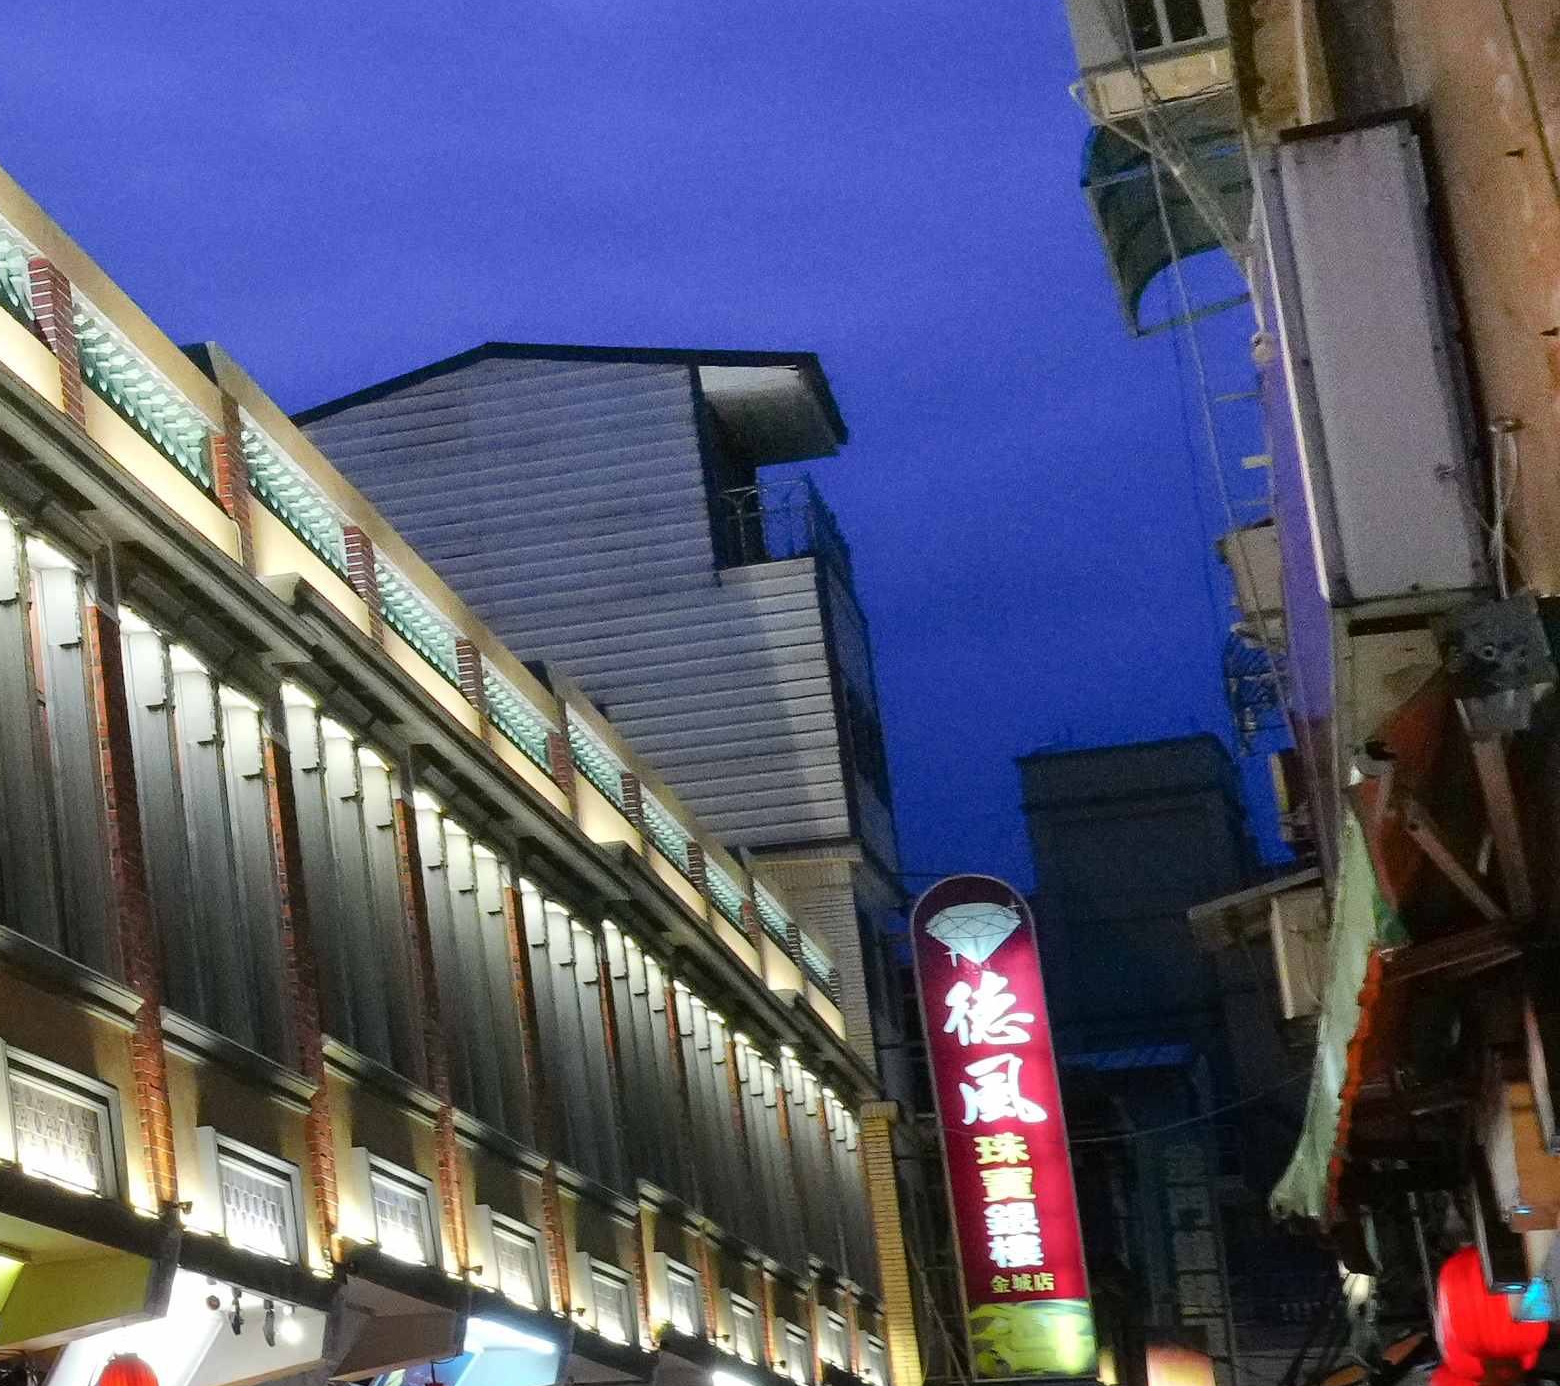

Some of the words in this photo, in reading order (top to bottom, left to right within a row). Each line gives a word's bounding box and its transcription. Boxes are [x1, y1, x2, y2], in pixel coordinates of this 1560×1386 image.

[974, 1131, 1044, 1269] 珠寶銀樓
[992, 1273, 1055, 1294] 金城店
